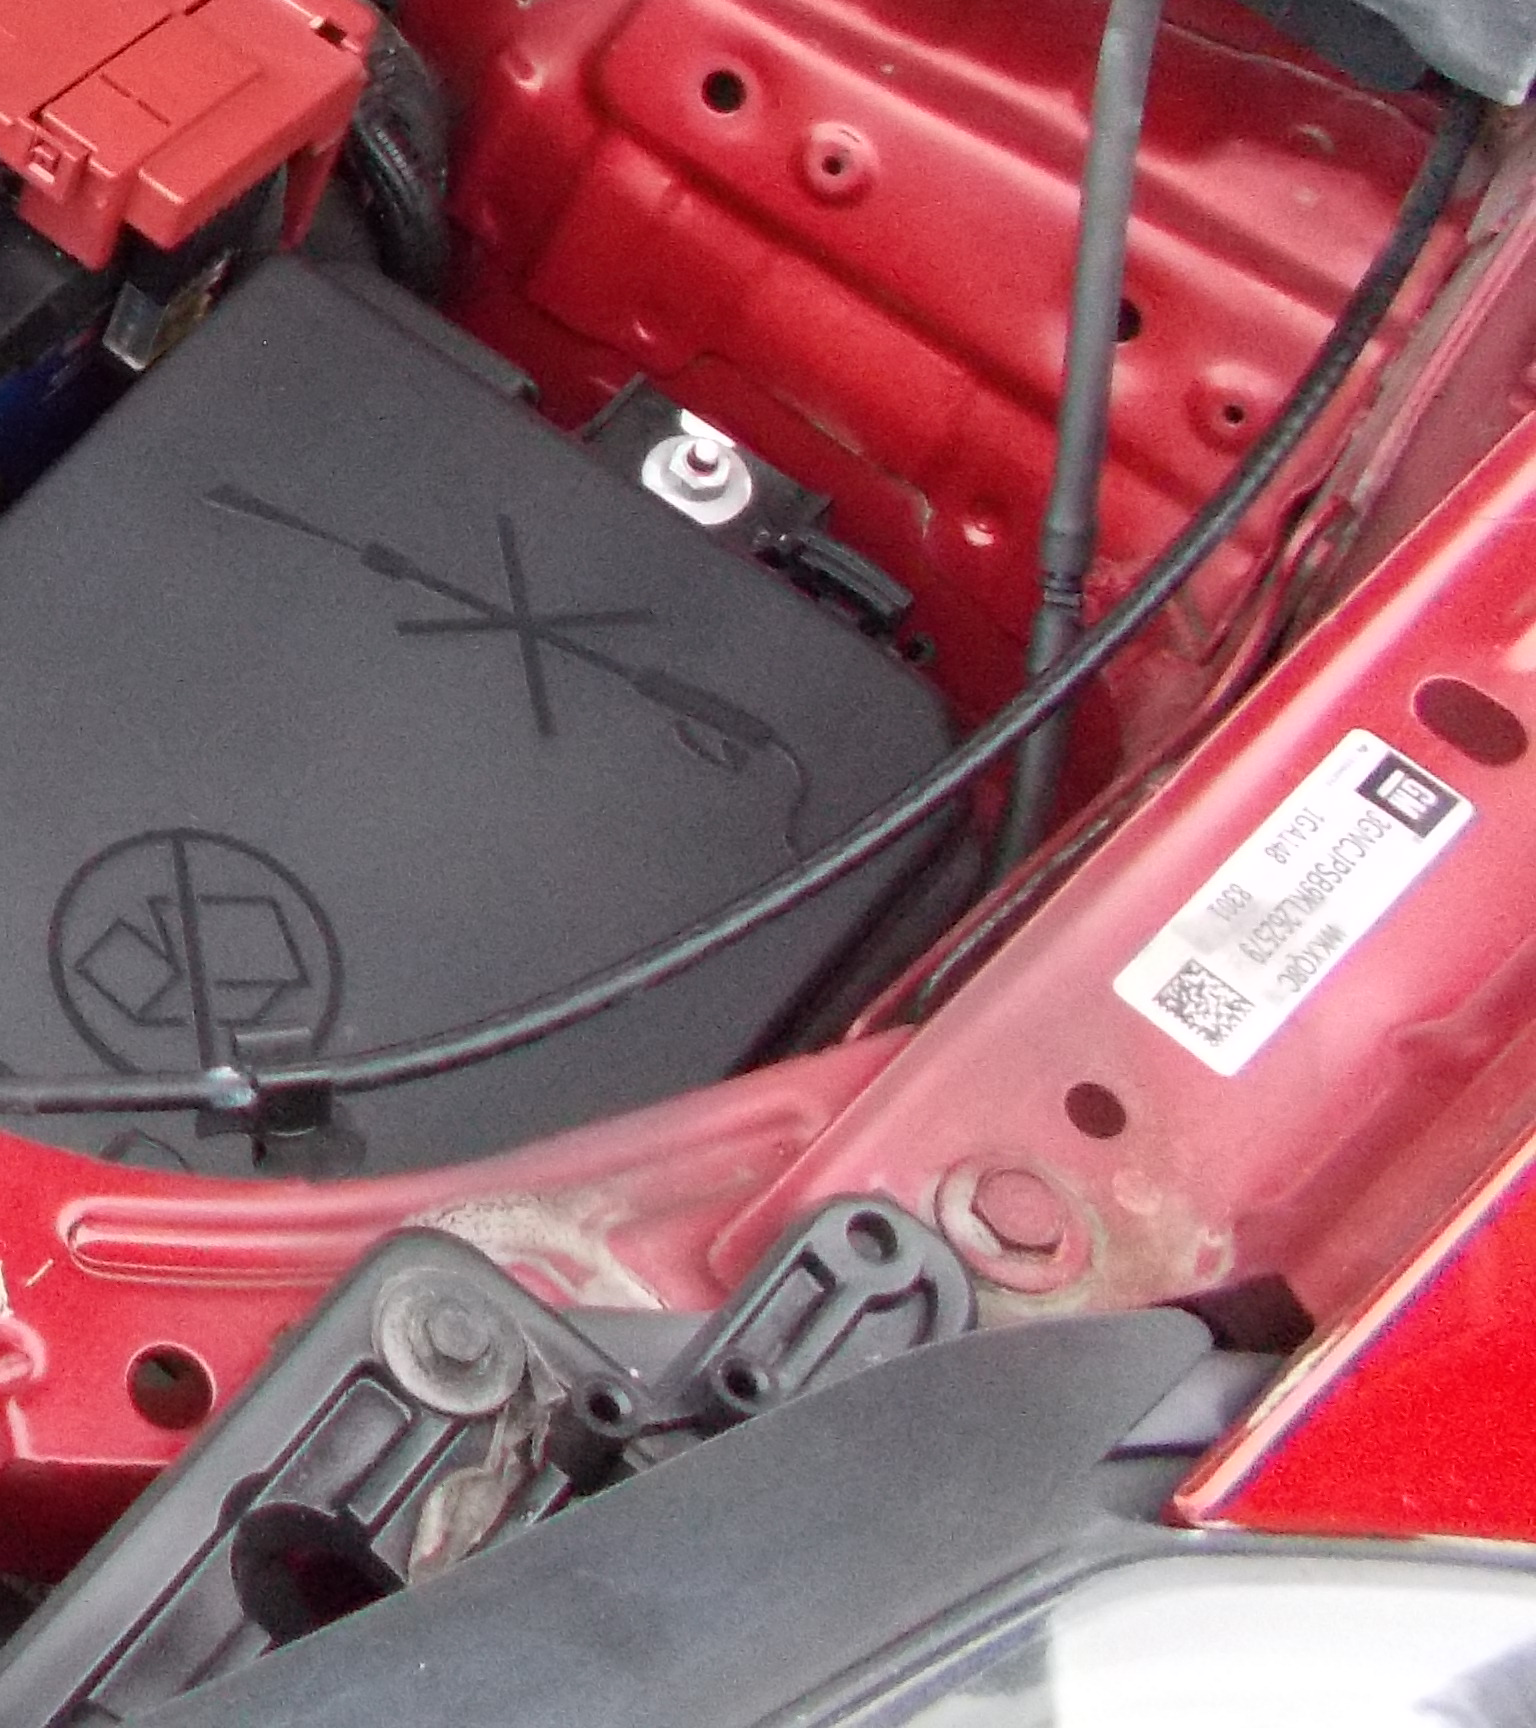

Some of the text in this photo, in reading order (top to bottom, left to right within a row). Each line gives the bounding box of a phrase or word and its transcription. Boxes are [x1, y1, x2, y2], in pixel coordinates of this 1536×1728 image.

[1387, 782, 1438, 820] GM
[1206, 805, 1326, 923] 1GA148 8301
